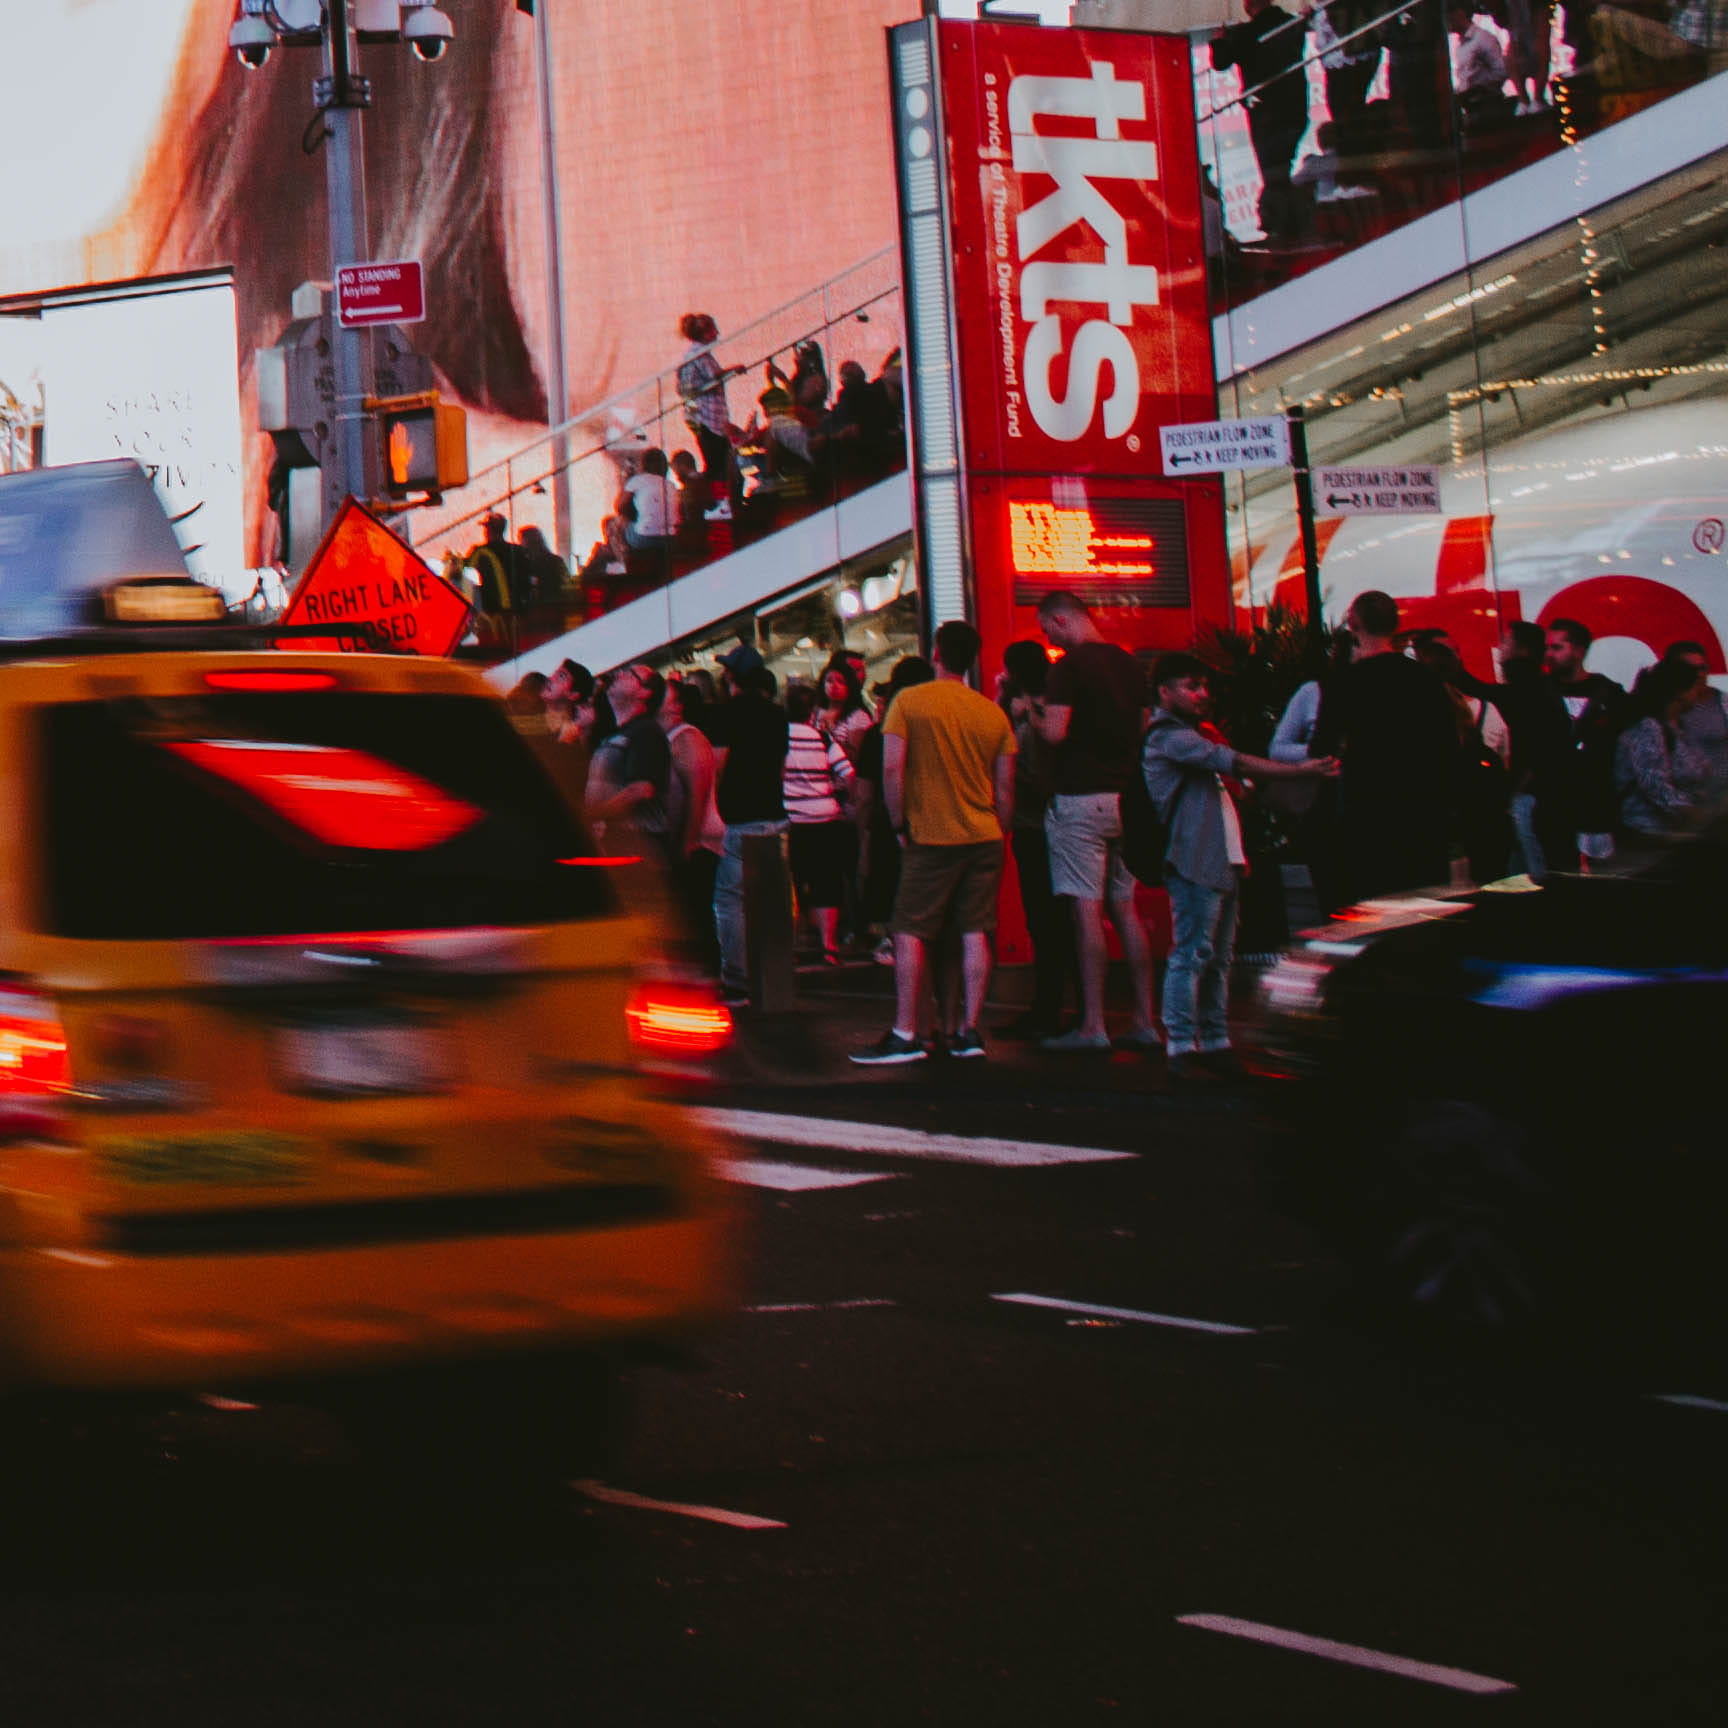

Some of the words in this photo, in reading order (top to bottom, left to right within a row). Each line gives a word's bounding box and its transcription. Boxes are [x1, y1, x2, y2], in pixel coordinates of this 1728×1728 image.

[985, 90, 1002, 159] service
[993, 186, 1009, 257] Theatre
[1007, 61, 1161, 441] tkts
[341, 270, 355, 284] NO
[357, 266, 402, 284] STANDING
[342, 283, 382, 299] Anytime
[997, 263, 1018, 385] Development
[1007, 391, 1023, 438] Fund
[1165, 428, 1221, 446] PEDESTRIAN
[1223, 425, 1248, 443] FLOW
[1250, 423, 1274, 440] ZONE
[1215, 447, 1239, 464] KEEP
[1240, 444, 1277, 462] MOVING
[1322, 471, 1381, 488] PEDESTRIAN
[1382, 471, 1408, 487] FLOW
[1409, 471, 1435, 487] ZONE
[1374, 493, 1399, 508] KEEP
[1400, 492, 1436, 507] MOVING
[305, 585, 369, 622] RIGHT
[376, 573, 432, 609] LANE
